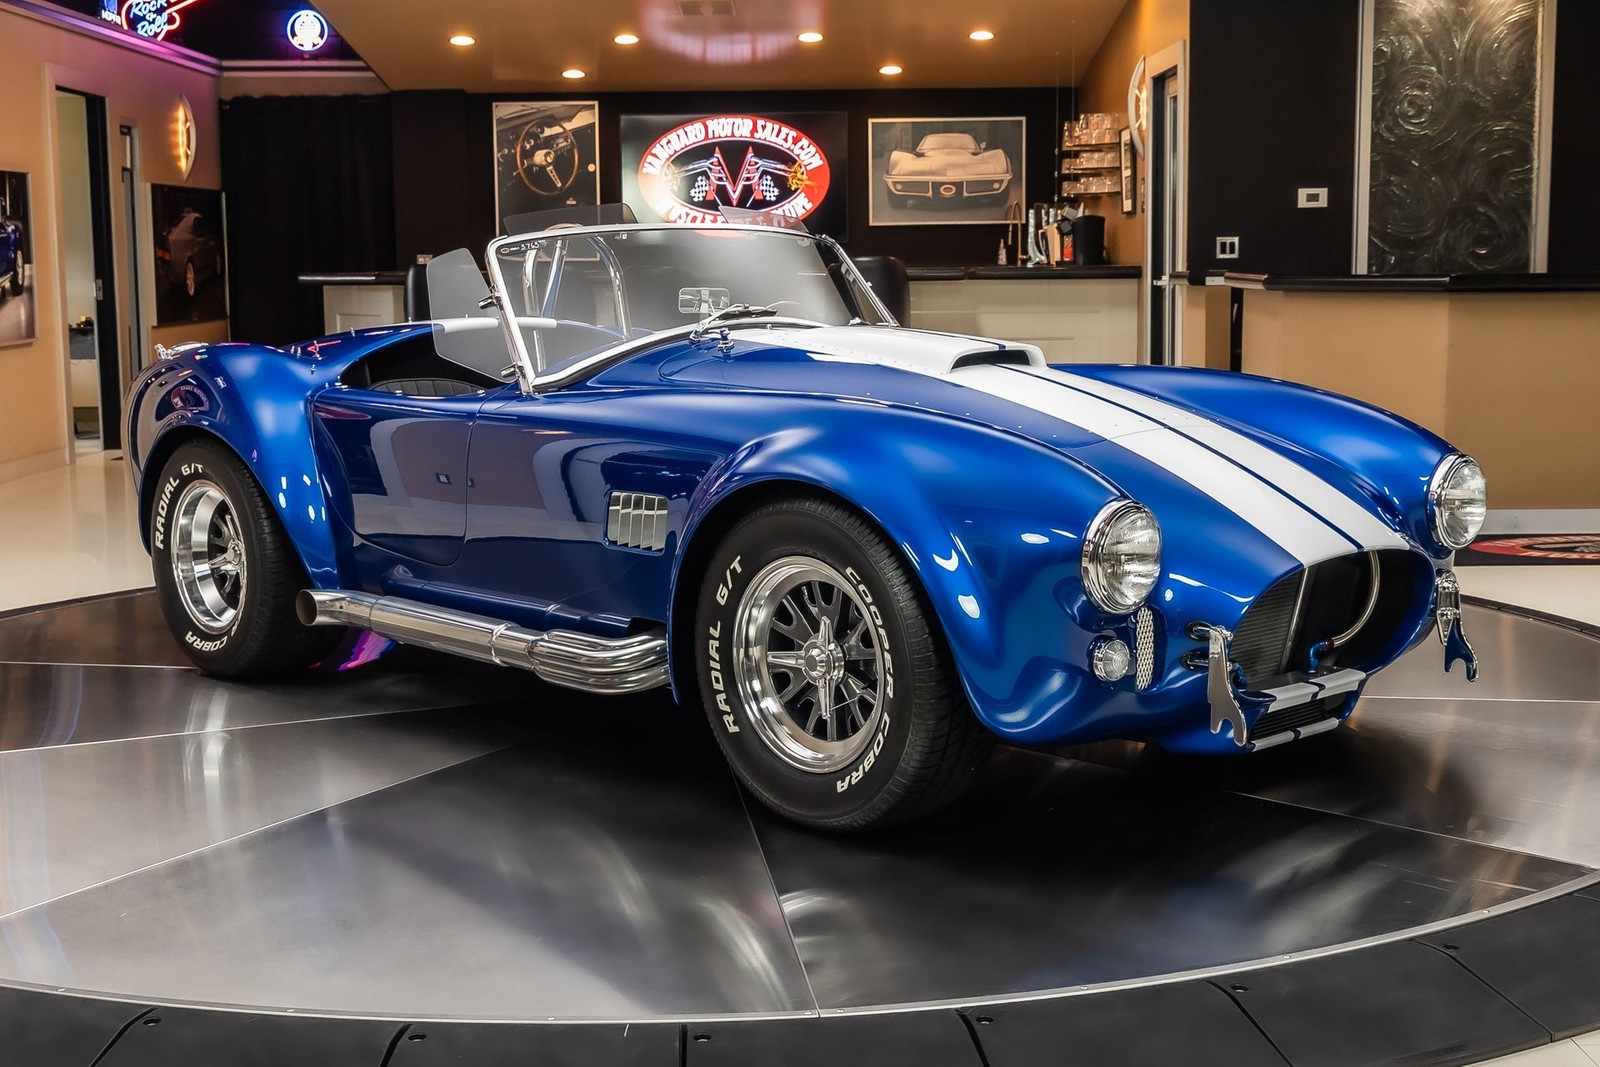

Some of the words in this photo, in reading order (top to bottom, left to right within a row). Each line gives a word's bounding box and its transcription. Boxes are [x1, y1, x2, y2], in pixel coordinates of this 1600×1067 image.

[642, 122, 706, 176] VANGUARD
[706, 117, 753, 139] MOTOR
[754, 119, 824, 171] SALES.COM
[155, 476, 180, 550] RADIAL
[181, 462, 204, 476] G/T
[715, 555, 742, 606] G/T
[185, 630, 228, 652] COBRA
[845, 566, 894, 699] COOPER
[710, 620, 740, 734] RADIAL
[836, 711, 890, 793] COBRA
